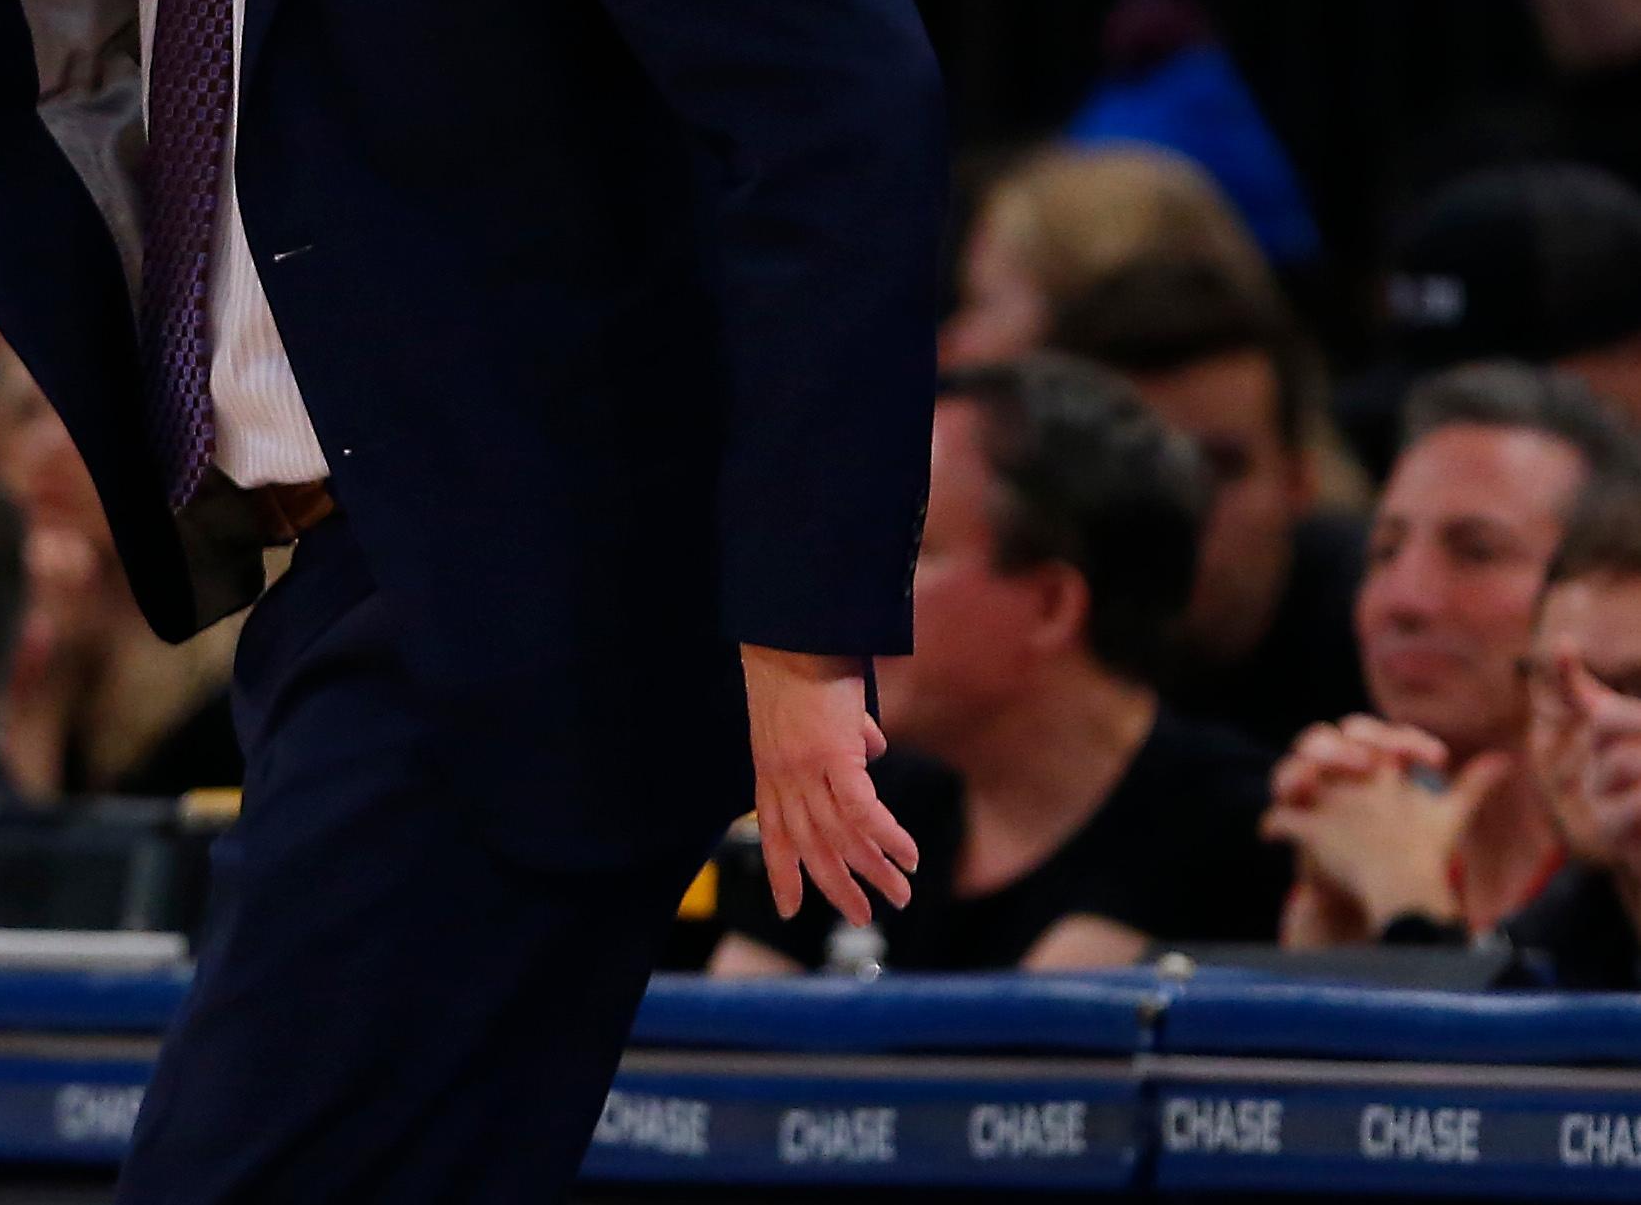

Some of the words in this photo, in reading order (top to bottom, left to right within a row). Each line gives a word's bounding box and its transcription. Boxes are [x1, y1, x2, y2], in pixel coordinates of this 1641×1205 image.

[778, 1107, 898, 1164] CHASE
[968, 1100, 1087, 1159] CHASE
[1164, 1098, 1284, 1155] CHASE
[1360, 1103, 1482, 1164] CHASE
